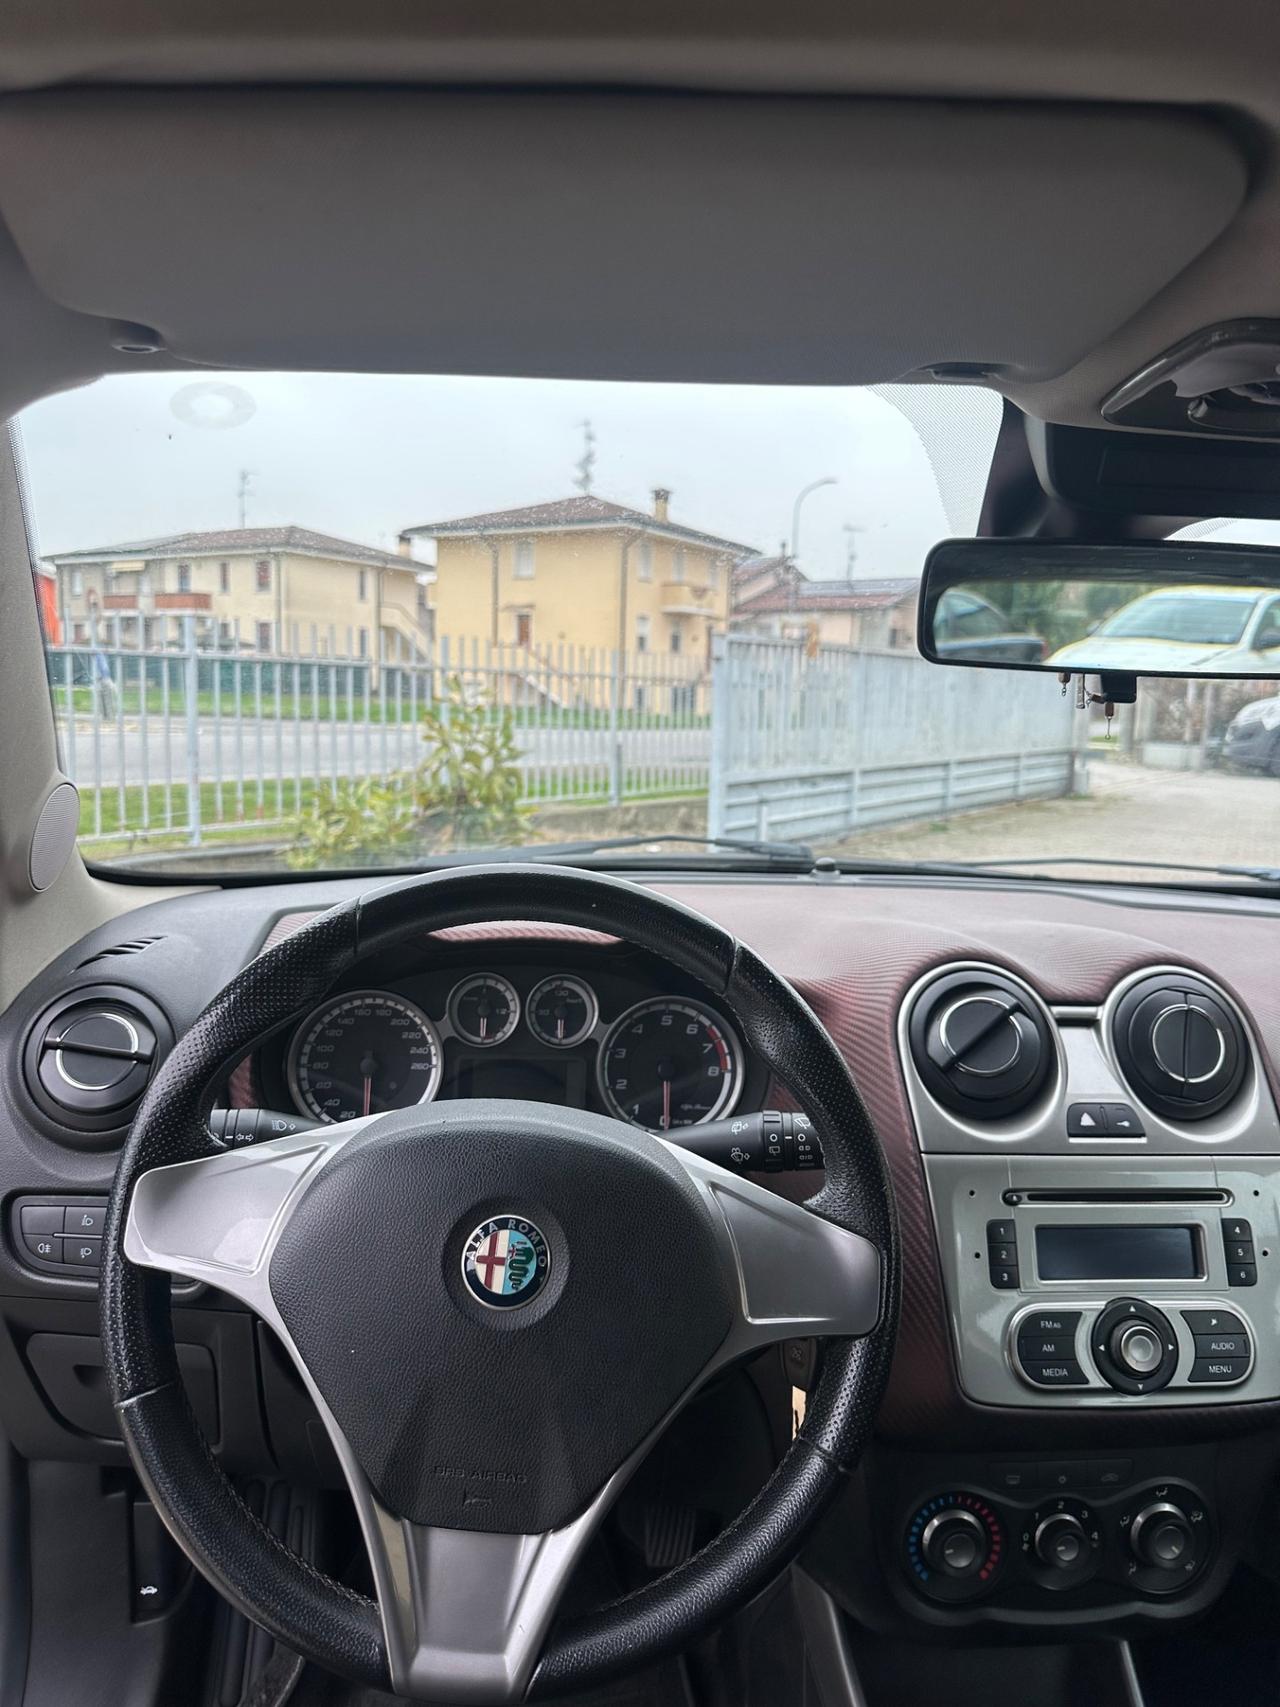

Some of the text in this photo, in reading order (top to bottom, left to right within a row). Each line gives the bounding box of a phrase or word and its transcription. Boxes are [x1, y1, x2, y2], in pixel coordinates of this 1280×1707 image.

[390, 1018, 410, 1026] 200
[661, 1015, 673, 1026] 5
[632, 1024, 643, 1034] 4
[686, 1024, 699, 1034] 6
[410, 1047, 428, 1055] 240
[702, 1043, 713, 1053] 7
[615, 1048, 626, 1058] 3
[707, 1066, 719, 1077] 8
[615, 1079, 627, 1089] 2
[324, 1098, 340, 1106] 40
[632, 1104, 640, 1115] 1
[340, 1111, 356, 1119] 20
[1234, 1226, 1241, 1234] 4
[466, 1219, 547, 1267] ALFA ROMEO
[1001, 1251, 1007, 1259] 2
[1002, 1273, 1008, 1281] 3
[1240, 1271, 1246, 1279] 6
[1042, 1344, 1055, 1352] AM
[1211, 1342, 1235, 1350] AUDIO
[1042, 1368, 1068, 1377] MEDIA
[1209, 1365, 1232, 1374] MENU
[1057, 1501, 1064, 1509] 2
[1081, 1510, 1088, 1519] 3
[1023, 1532, 1030, 1541] 0
[1091, 1531, 1098, 1540] 4
